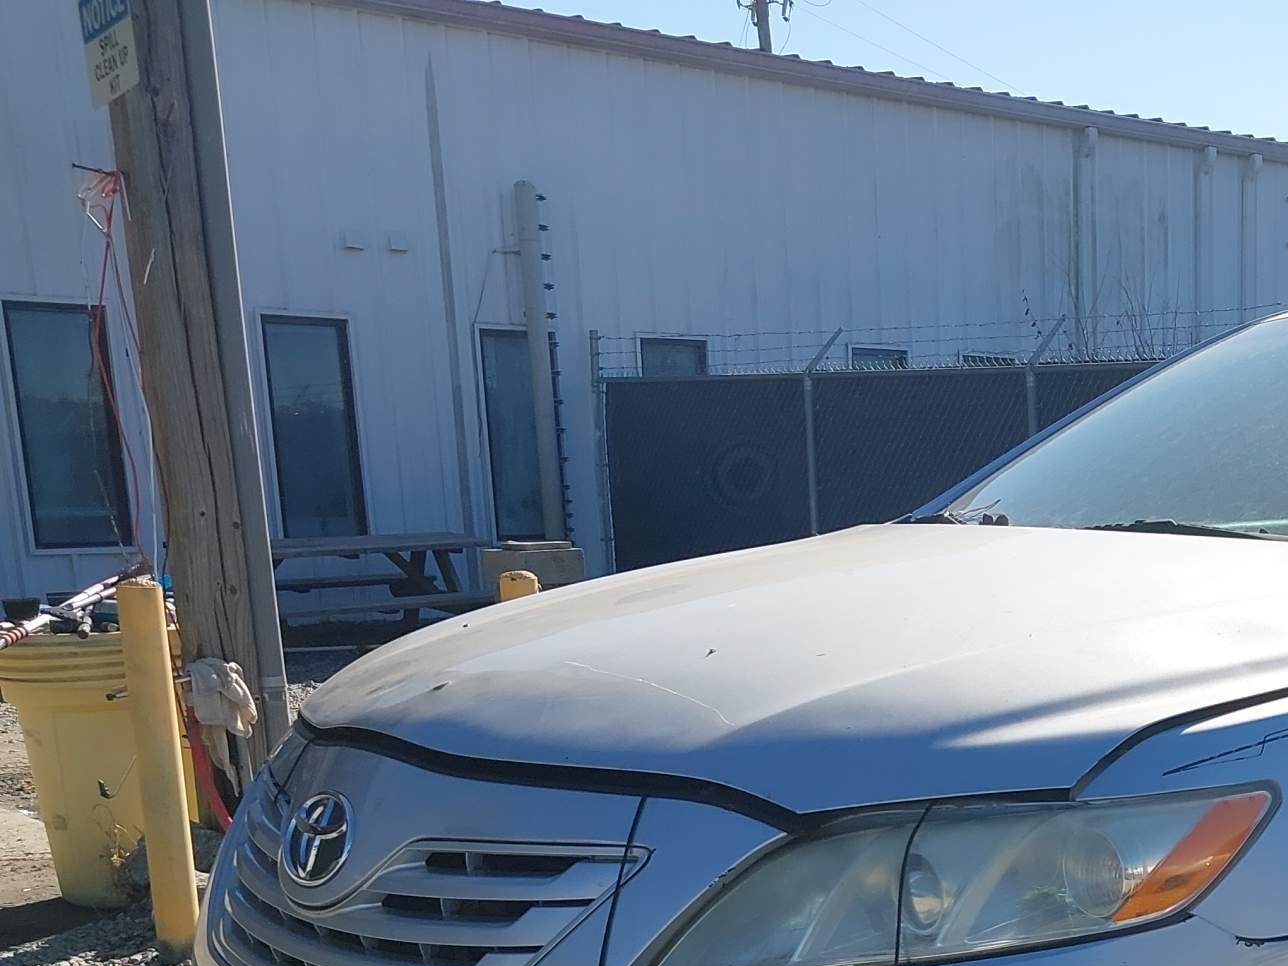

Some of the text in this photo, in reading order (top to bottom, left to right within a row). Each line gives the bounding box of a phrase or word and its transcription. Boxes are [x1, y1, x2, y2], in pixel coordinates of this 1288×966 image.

[99, 30, 119, 57] SPILL
[95, 45, 129, 81] CLEAN UP
[109, 73, 121, 95] KIT
